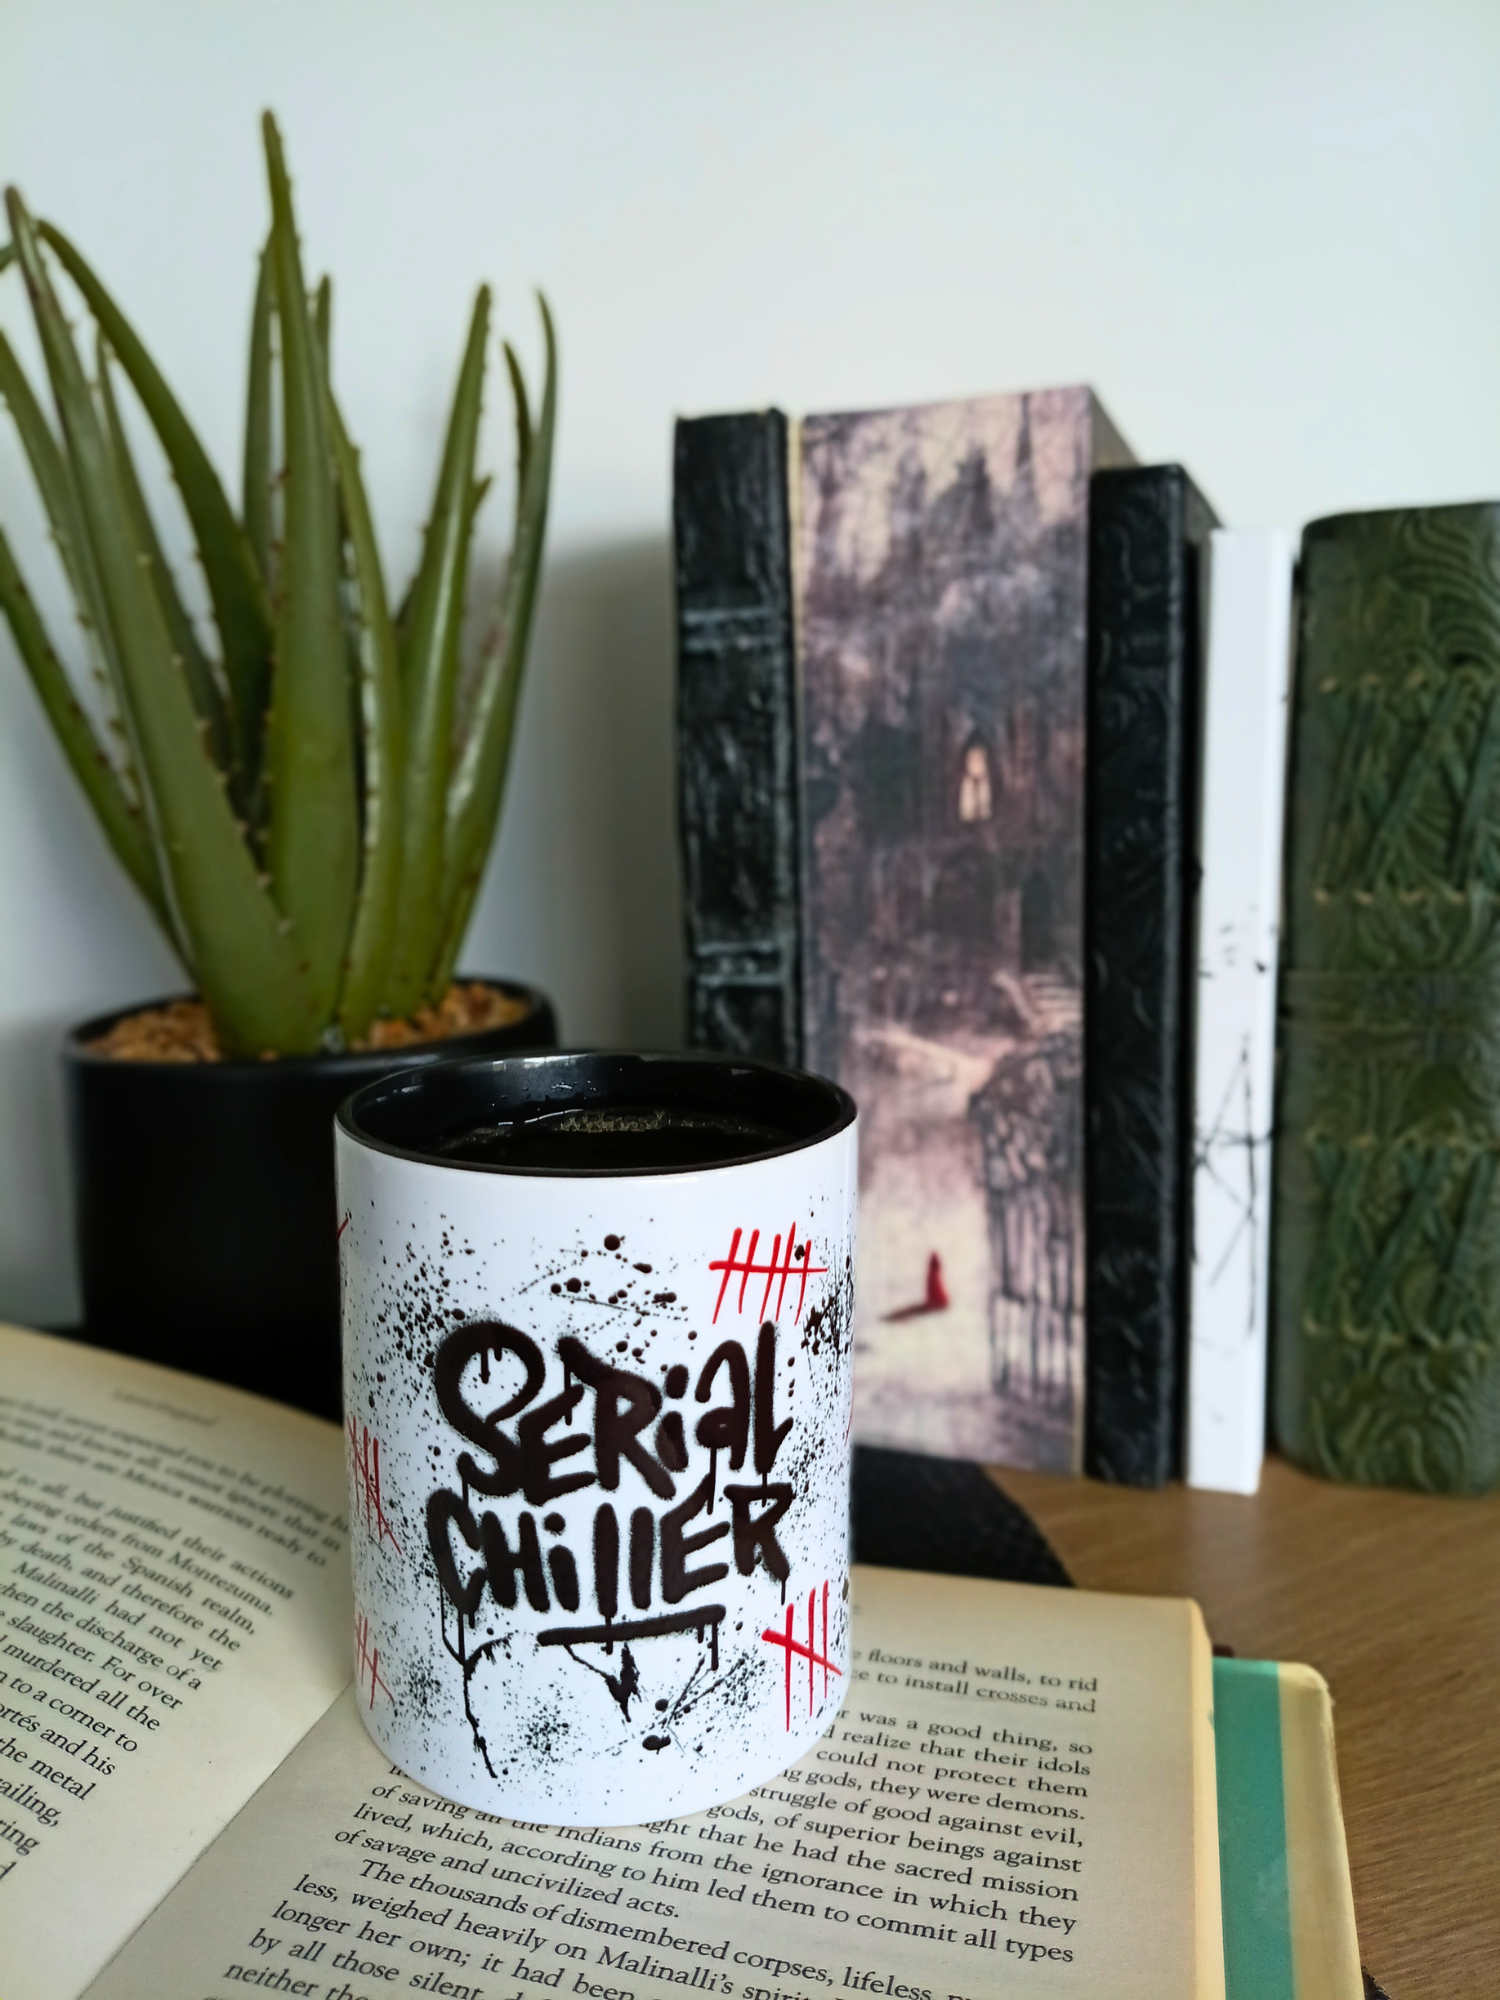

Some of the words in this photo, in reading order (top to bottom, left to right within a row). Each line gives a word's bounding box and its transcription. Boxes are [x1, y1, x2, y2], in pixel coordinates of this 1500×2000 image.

[10, 1512, 49, 1535] laws
[56, 1533, 83, 1545] of
[83, 1541, 115, 1560] the
[121, 1556, 193, 1599] Spanish
[201, 1596, 255, 1636] realm,
[64, 1517, 118, 1538] orders
[121, 1532, 163, 1558] from
[167, 1551, 272, 1616] Montezuma.
[105, 1505, 181, 1540] justified
[182, 1536, 226, 1562] their
[230, 1560, 294, 1600] actions
[257, 1525, 304, 1554] ready
[306, 1551, 327, 1568] to
[11, 1561, 100, 1606] Malinalli
[103, 1599, 147, 1626] had
[148, 1624, 185, 1649] not
[189, 1647, 223, 1672] yet
[20, 1541, 73, 1571] death,
[80, 1567, 122, 1588] and
[121, 1583, 203, 1630] therefore
[208, 1627, 240, 1652] the
[6, 1615, 97, 1663] slaughter.
[98, 1654, 137, 1683] For
[138, 1680, 183, 1710] over
[41, 1601, 74, 1622] the
[75, 1616, 164, 1668] discharge
[166, 1664, 195, 1682] of
[187, 1676, 202, 1690] a
[868, 1647, 922, 1669] floors
[929, 1659, 968, 1675] and
[974, 1663, 1031, 1685] walls,
[1040, 1673, 1061, 1688] to
[1068, 1677, 1098, 1692] rid
[2, 1643, 101, 1694] murdered
[95, 1690, 129, 1710] all
[126, 1704, 160, 1731] the
[9, 1677, 33, 1694] to
[32, 1689, 48, 1703] a
[48, 1698, 116, 1739] corner
[114, 1732, 138, 1753] to
[877, 1670, 898, 1685] to
[905, 1674, 969, 1695] install
[976, 1686, 1048, 1708] crosses
[1055, 1699, 1096, 1713] and
[0, 1702, 41, 1732] rtés
[40, 1728, 88, 1757] and
[80, 1746, 116, 1776] his
[843, 1730, 910, 1751] realize
[920, 1739, 965, 1759] that
[974, 1747, 1028, 1768] their
[1037, 1756, 1090, 1776] idols
[860, 1711, 897, 1727] was
[906, 1719, 918, 1730] a
[927, 1722, 982, 1740] good
[992, 1728, 1057, 1752] thing,
[1069, 1741, 1092, 1755] so
[29, 1758, 97, 1801] metal
[805, 1771, 862, 1791] gods,
[870, 1776, 920, 1800] they
[926, 1786, 980, 1805] were
[986, 1792, 1085, 1820] demons.
[816, 1749, 878, 1768] could
[886, 1759, 925, 1775] not
[934, 1765, 1017, 1787] protect
[1028, 1776, 1088, 1798] them
[706, 1804, 764, 1826] gods,
[774, 1813, 802, 1829] of
[804, 1820, 900, 1846] superior
[908, 1830, 985, 1861] beings
[993, 1847, 1082, 1873] against
[749, 1787, 837, 1810] struggle
[844, 1798, 871, 1814] of
[872, 1804, 932, 1824] good
[938, 1813, 1023, 1837] against
[1031, 1827, 1082, 1848] evil,
[335, 1829, 365, 1845] of
[361, 1836, 436, 1865] savage
[440, 1855, 490, 1876] and
[492, 1868, 624, 1906] uncivilized
[625, 1892, 680, 1918] acts.
[352, 1803, 413, 1833] lived,
[421, 1821, 493, 1851] which,
[501, 1840, 617, 1879] according
[621, 1863, 646, 1881] to
[651, 1867, 700, 1893] him
[706, 1878, 747, 1903] led
[751, 1889, 816, 1917] them
[824, 1905, 849, 1923] to
[857, 1913, 957, 1943] commit
[964, 1928, 997, 1950] all
[1005, 1937, 1074, 1962] types
[372, 1785, 401, 1799] of
[399, 1792, 470, 1819] saving
[555, 1826, 642, 1853] Indians
[648, 1840, 703, 1866] from
[713, 1853, 753, 1875] the
[761, 1862, 883, 1899] ignorance
[893, 1886, 918, 1906] in
[929, 1893, 1007, 1921] which
[1018, 1905, 1076, 1935] they
[699, 1824, 747, 1847] that
[753, 1832, 783, 1853] he
[791, 1839, 838, 1863] had
[847, 1850, 886, 1871] the
[894, 1859, 973, 1886] sacred
[981, 1875, 1079, 1902] mission
[271, 1900, 352, 1935] longer
[356, 1920, 402, 1947] her
[409, 1939, 471, 1968] own;
[480, 1953, 504, 1973] it
[511, 1957, 566, 1988] had
[572, 1972, 636, 2000] been
[293, 1873, 339, 1902] less,
[351, 1890, 452, 1927] weighed
[454, 1912, 548, 1953] heavily
[554, 1941, 588, 1961] on
[596, 1945, 735, 1995] Malinalli's
[360, 1858, 405, 1885] The
[409, 1873, 527, 1915] thousands
[532, 1903, 564, 1922] of
[561, 1908, 730, 1960] dismembered
[733, 1949, 834, 1986] corpses,
[222, 1963, 319, 1998] neither
[248, 1927, 282, 1955] by
[288, 1940, 327, 1963] all
[331, 1949, 400, 1982] those
[409, 1970, 485, 2000] silent
